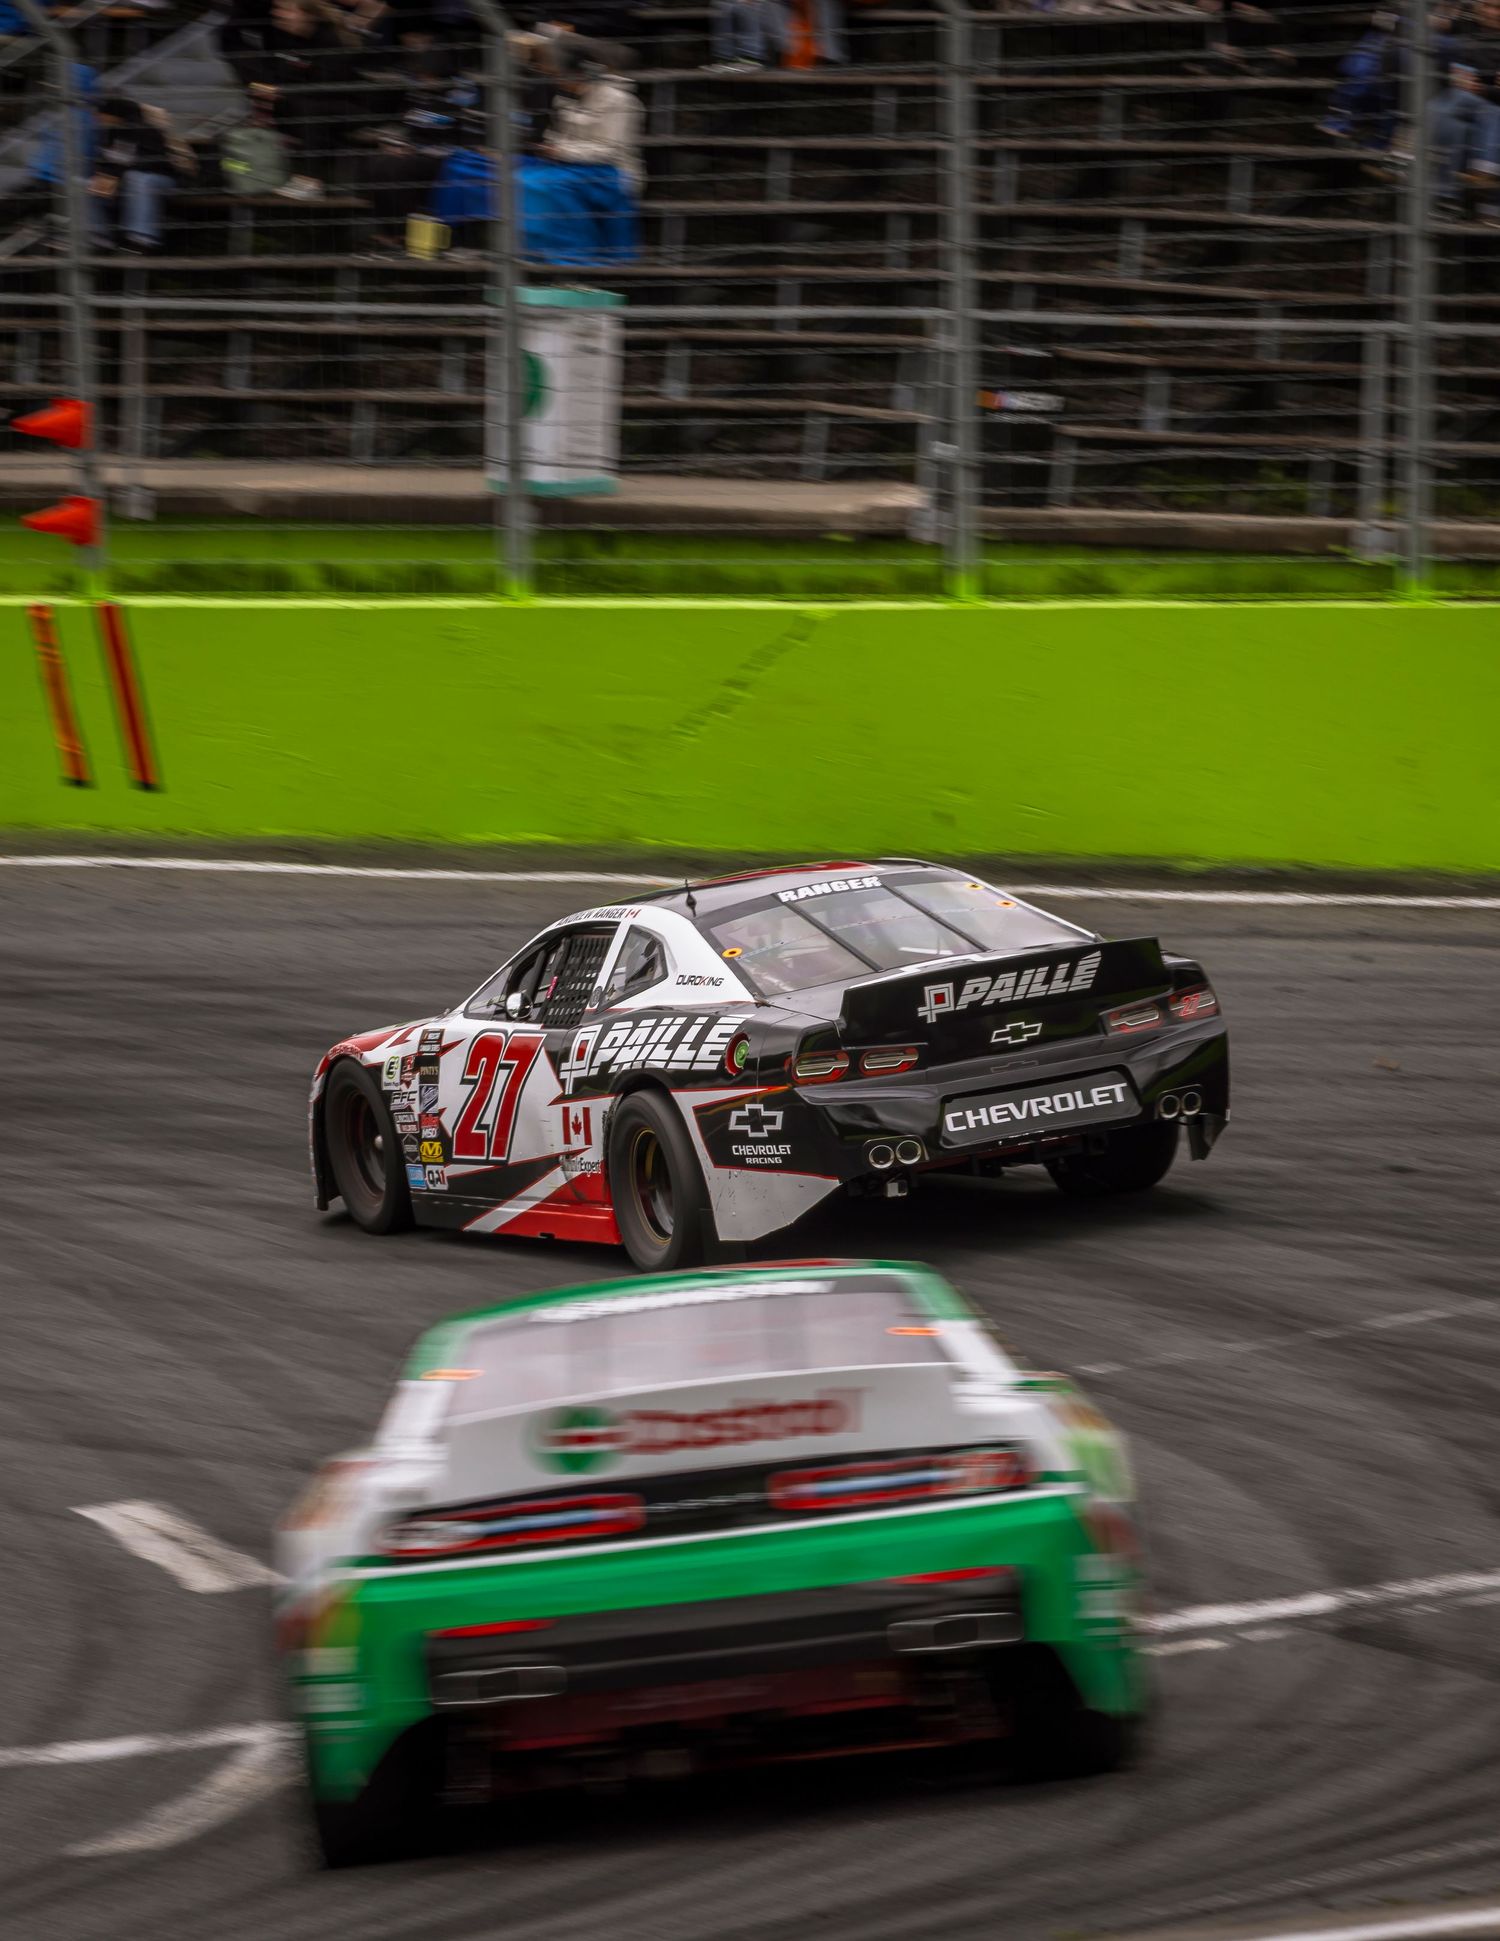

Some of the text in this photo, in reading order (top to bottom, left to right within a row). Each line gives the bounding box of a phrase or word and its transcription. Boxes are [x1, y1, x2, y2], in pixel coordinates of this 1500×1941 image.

[776, 876, 883, 903] RANGER
[593, 907, 627, 919] RANGER
[675, 974, 725, 987] DUROKING
[954, 951, 1102, 1012] PAILLÉ
[391, 1090, 418, 1103] PFC
[452, 1028, 547, 1166] 27
[944, 1082, 1128, 1133] CHEVROLET
[731, 1144, 792, 1156] CHEVROLET
[745, 1157, 783, 1165] RACING
